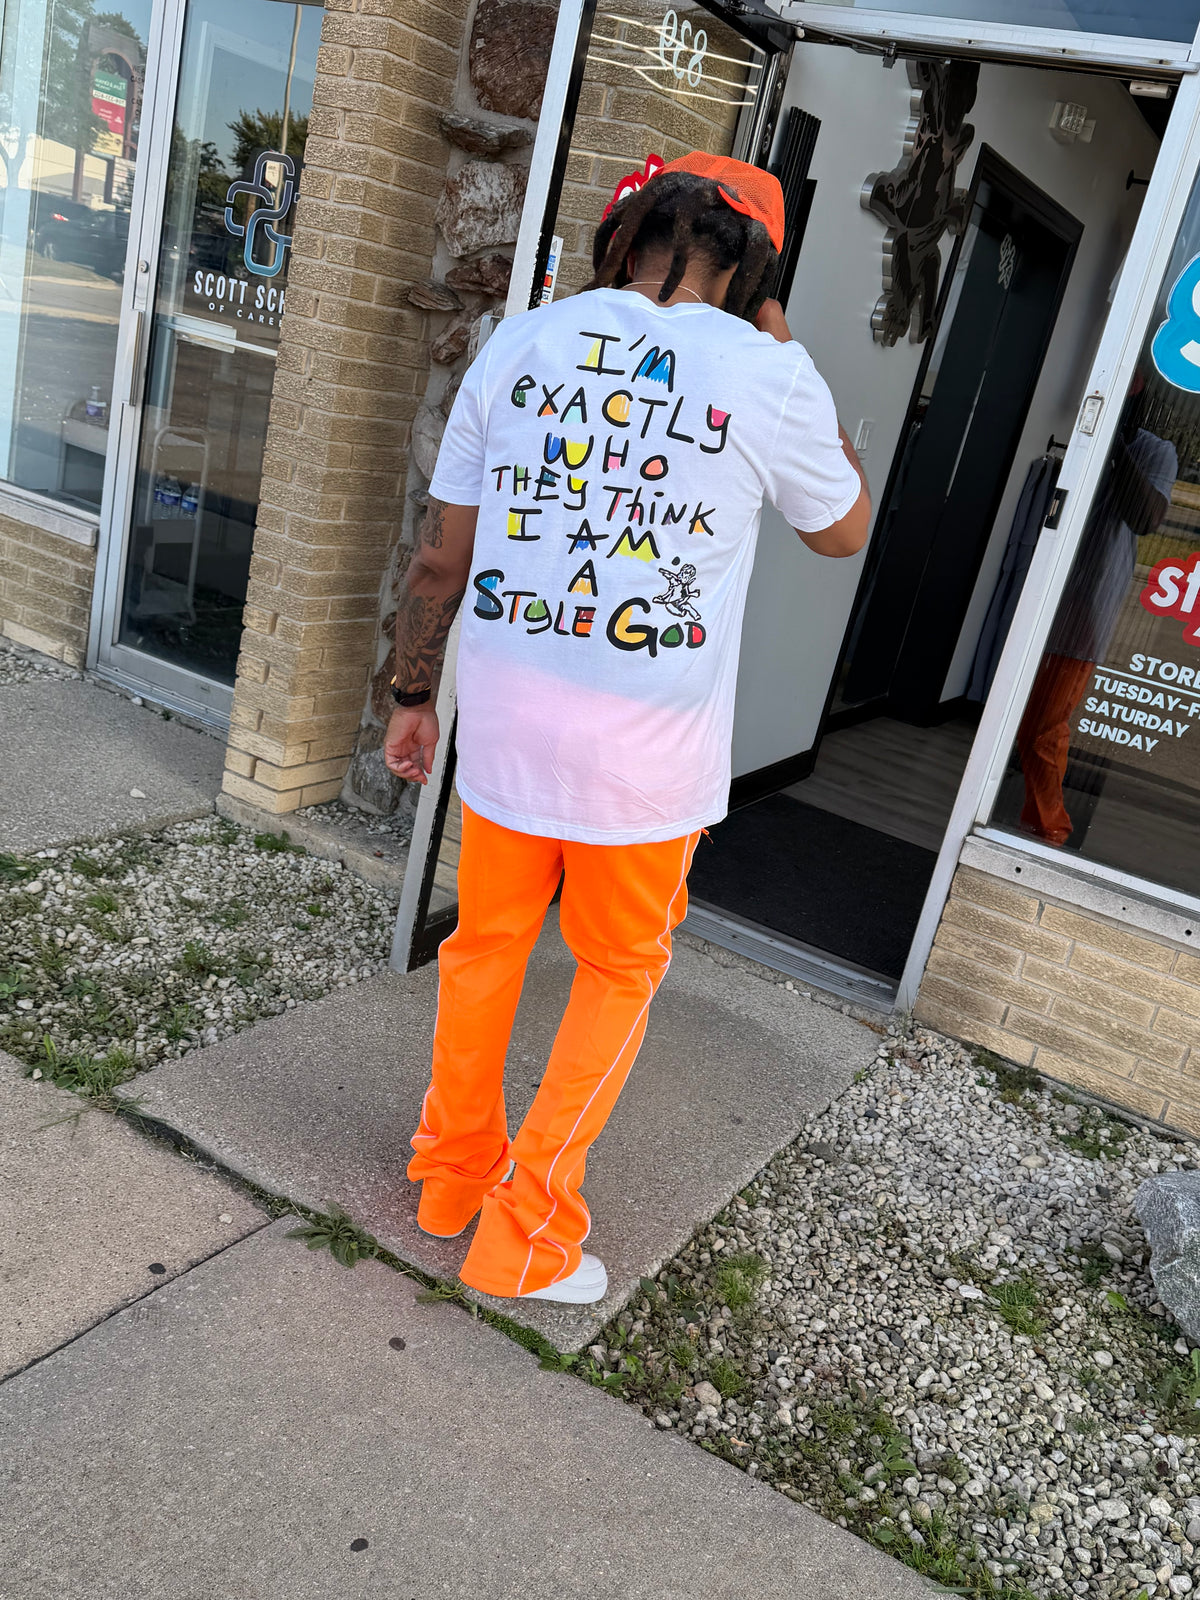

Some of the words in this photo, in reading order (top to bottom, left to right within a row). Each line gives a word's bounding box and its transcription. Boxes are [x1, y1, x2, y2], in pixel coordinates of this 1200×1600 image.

[193, 270, 249, 305] SCOTT
[208, 302, 225, 313] OF
[576, 331, 676, 392] I'M
[543, 432, 669, 481] WHO
[507, 507, 543, 541] I
[567, 558, 599, 598] A
[606, 597, 707, 658] GOD
[1085, 696, 1190, 738] SATURDAY
[1094, 674, 1200, 720] TUESDAY-F
[1077, 718, 1159, 753] SUNDAY
